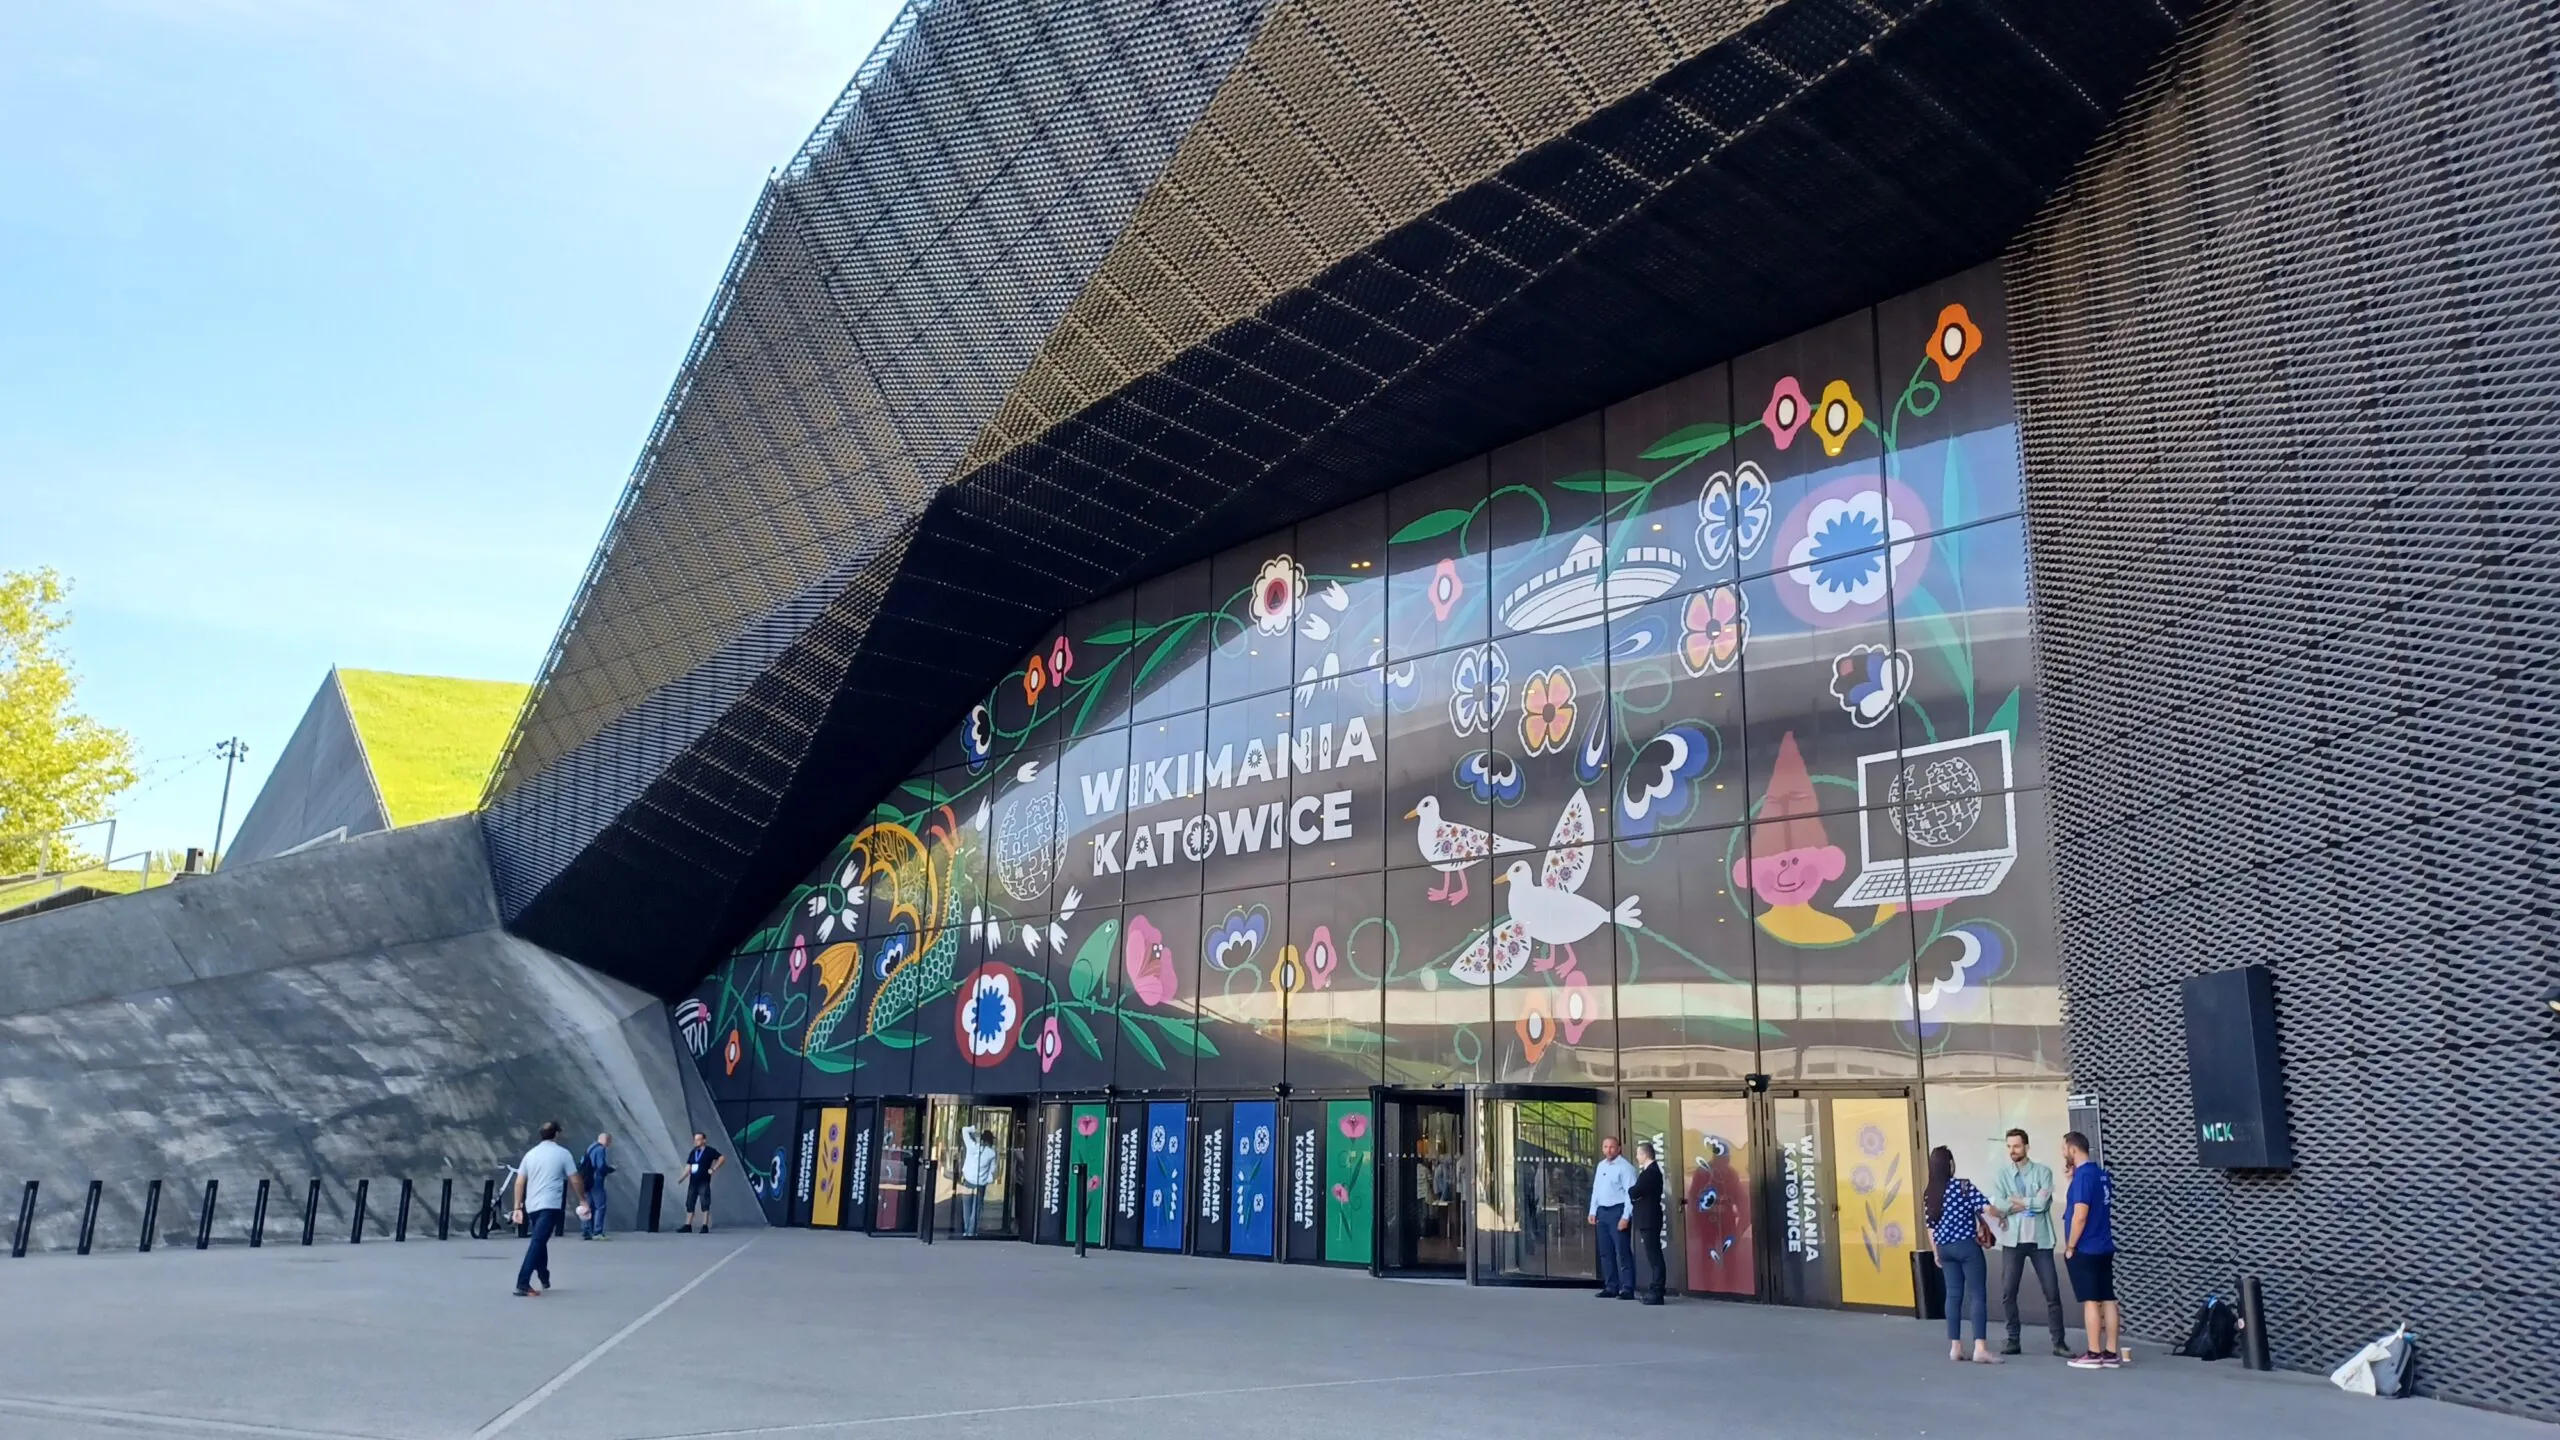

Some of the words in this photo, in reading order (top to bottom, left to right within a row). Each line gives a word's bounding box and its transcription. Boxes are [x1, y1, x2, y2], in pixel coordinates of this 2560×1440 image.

[1080, 716, 1377, 816] WIKIMANIA
[1093, 789, 1353, 877] KATOWICE
[1043, 1133, 1055, 1209] KATOWICE
[1050, 1127, 1063, 1215] WIKIMANIA
[1118, 1133, 1130, 1213] KATOWICE
[1126, 1127, 1139, 1219] WIKIMANIA
[1202, 1134, 1213, 1217] KATOWICE
[2202, 1121, 2234, 1142] MCK
[1211, 1128, 1222, 1224] WIKIMANIA
[1294, 1135, 1304, 1222] KATOWICE
[1304, 1129, 1315, 1229] WIKIMANIA
[1783, 1142, 1802, 1253] KATOWICE
[1800, 1134, 1819, 1262] WIKIMANIA
